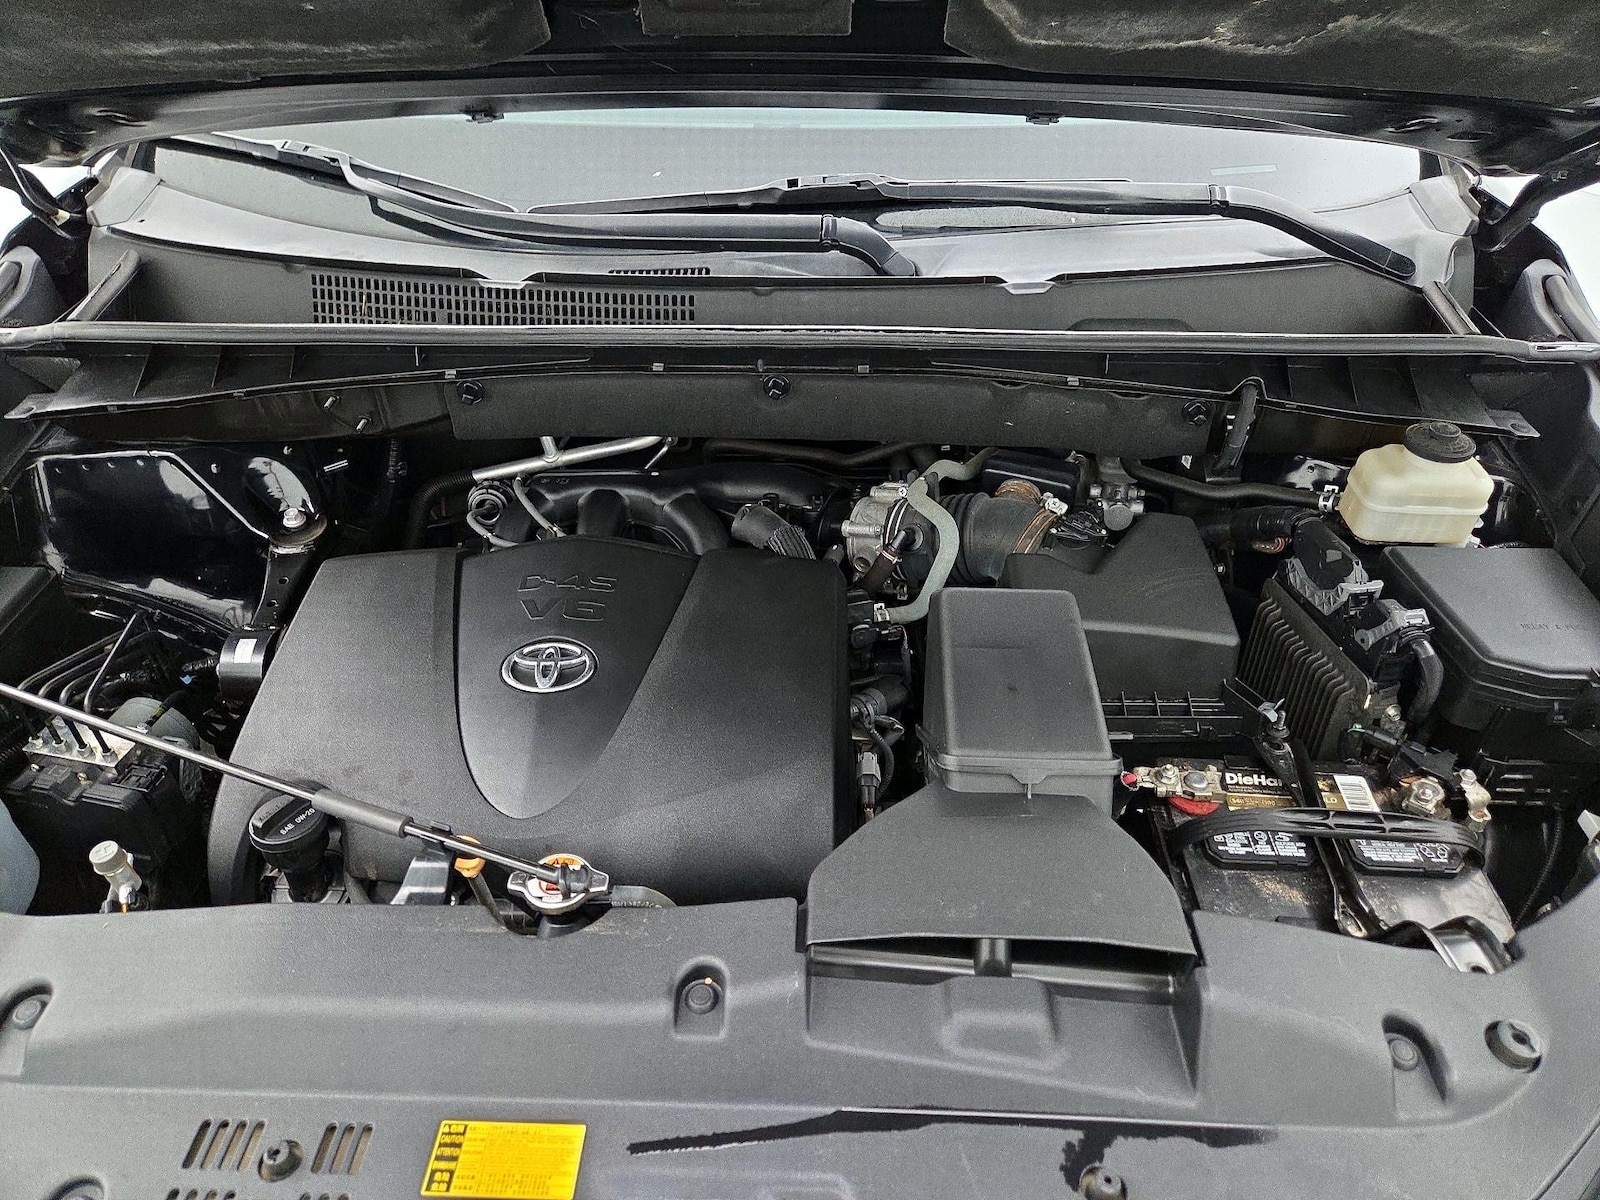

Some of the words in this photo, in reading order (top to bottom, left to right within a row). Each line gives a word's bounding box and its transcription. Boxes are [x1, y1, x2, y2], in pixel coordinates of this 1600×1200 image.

[518, 574, 617, 593] D-4S
[519, 598, 606, 622] V6
[279, 823, 295, 835] SAE
[295, 808, 316, 824] 0W-20
[440, 1134, 464, 1144] CAUTION
